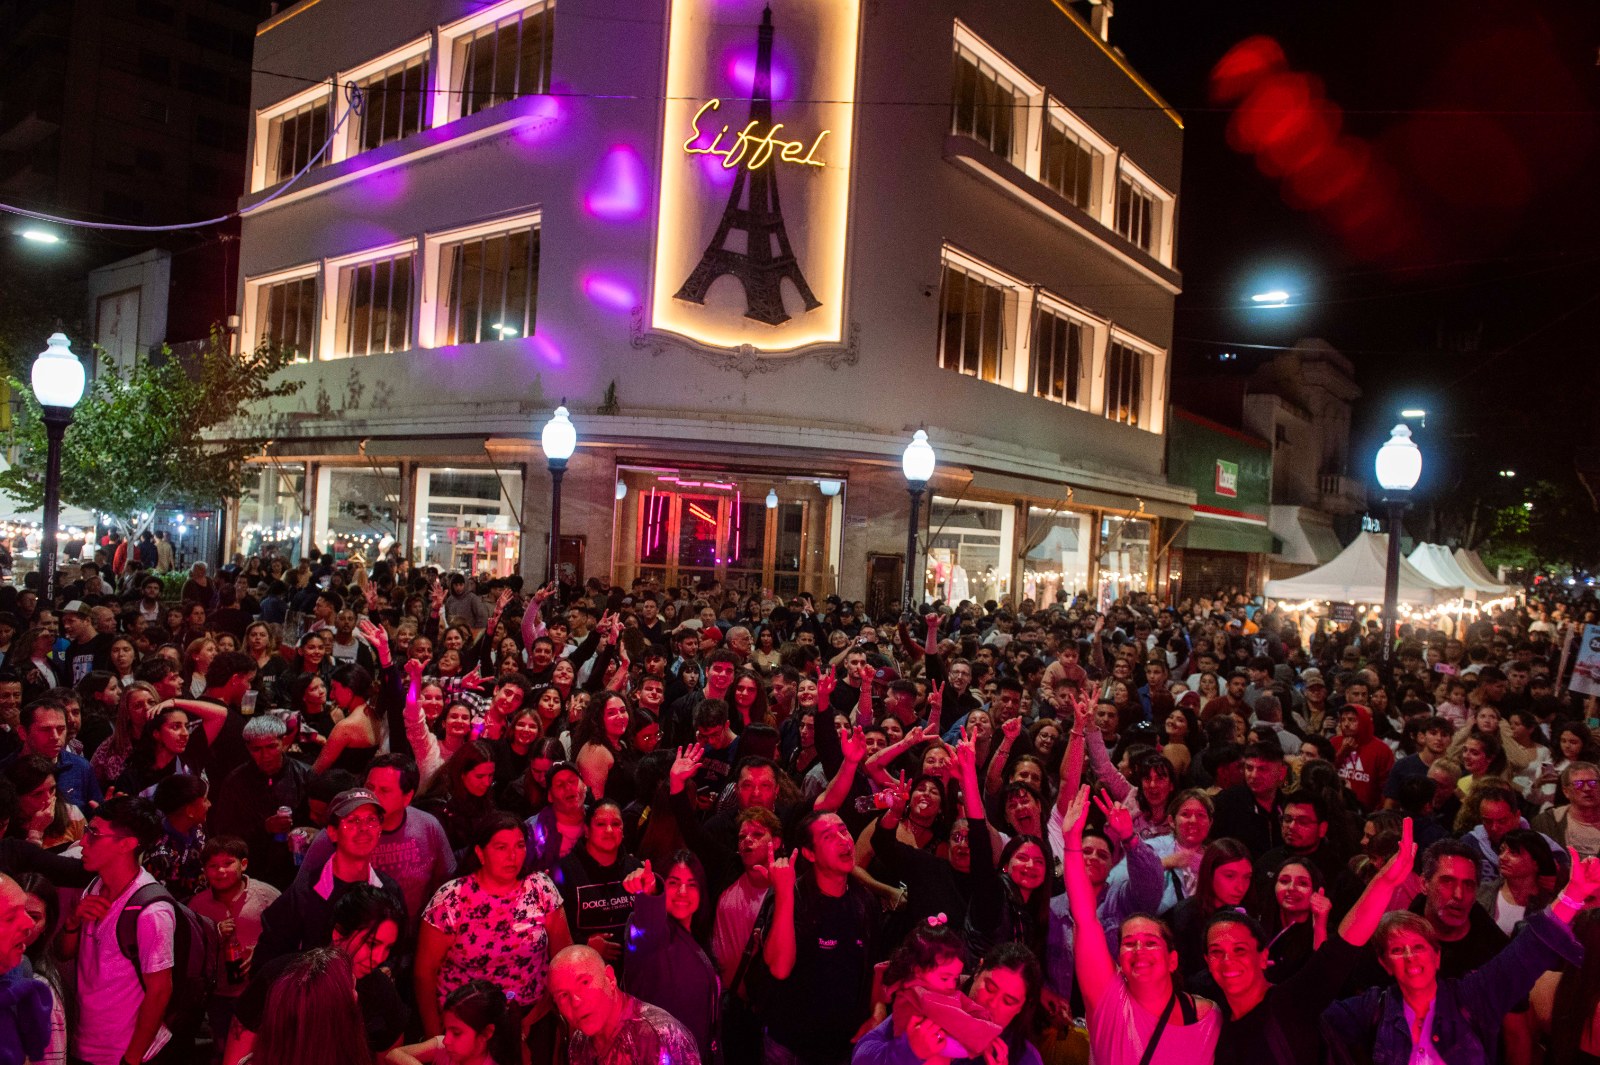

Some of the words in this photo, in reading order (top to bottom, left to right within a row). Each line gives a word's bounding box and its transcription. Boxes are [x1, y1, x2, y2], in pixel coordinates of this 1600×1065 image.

[683, 98, 832, 170] Eiffel
[1337, 768, 1370, 783] didas
[582, 900, 607, 910] DOLCE
